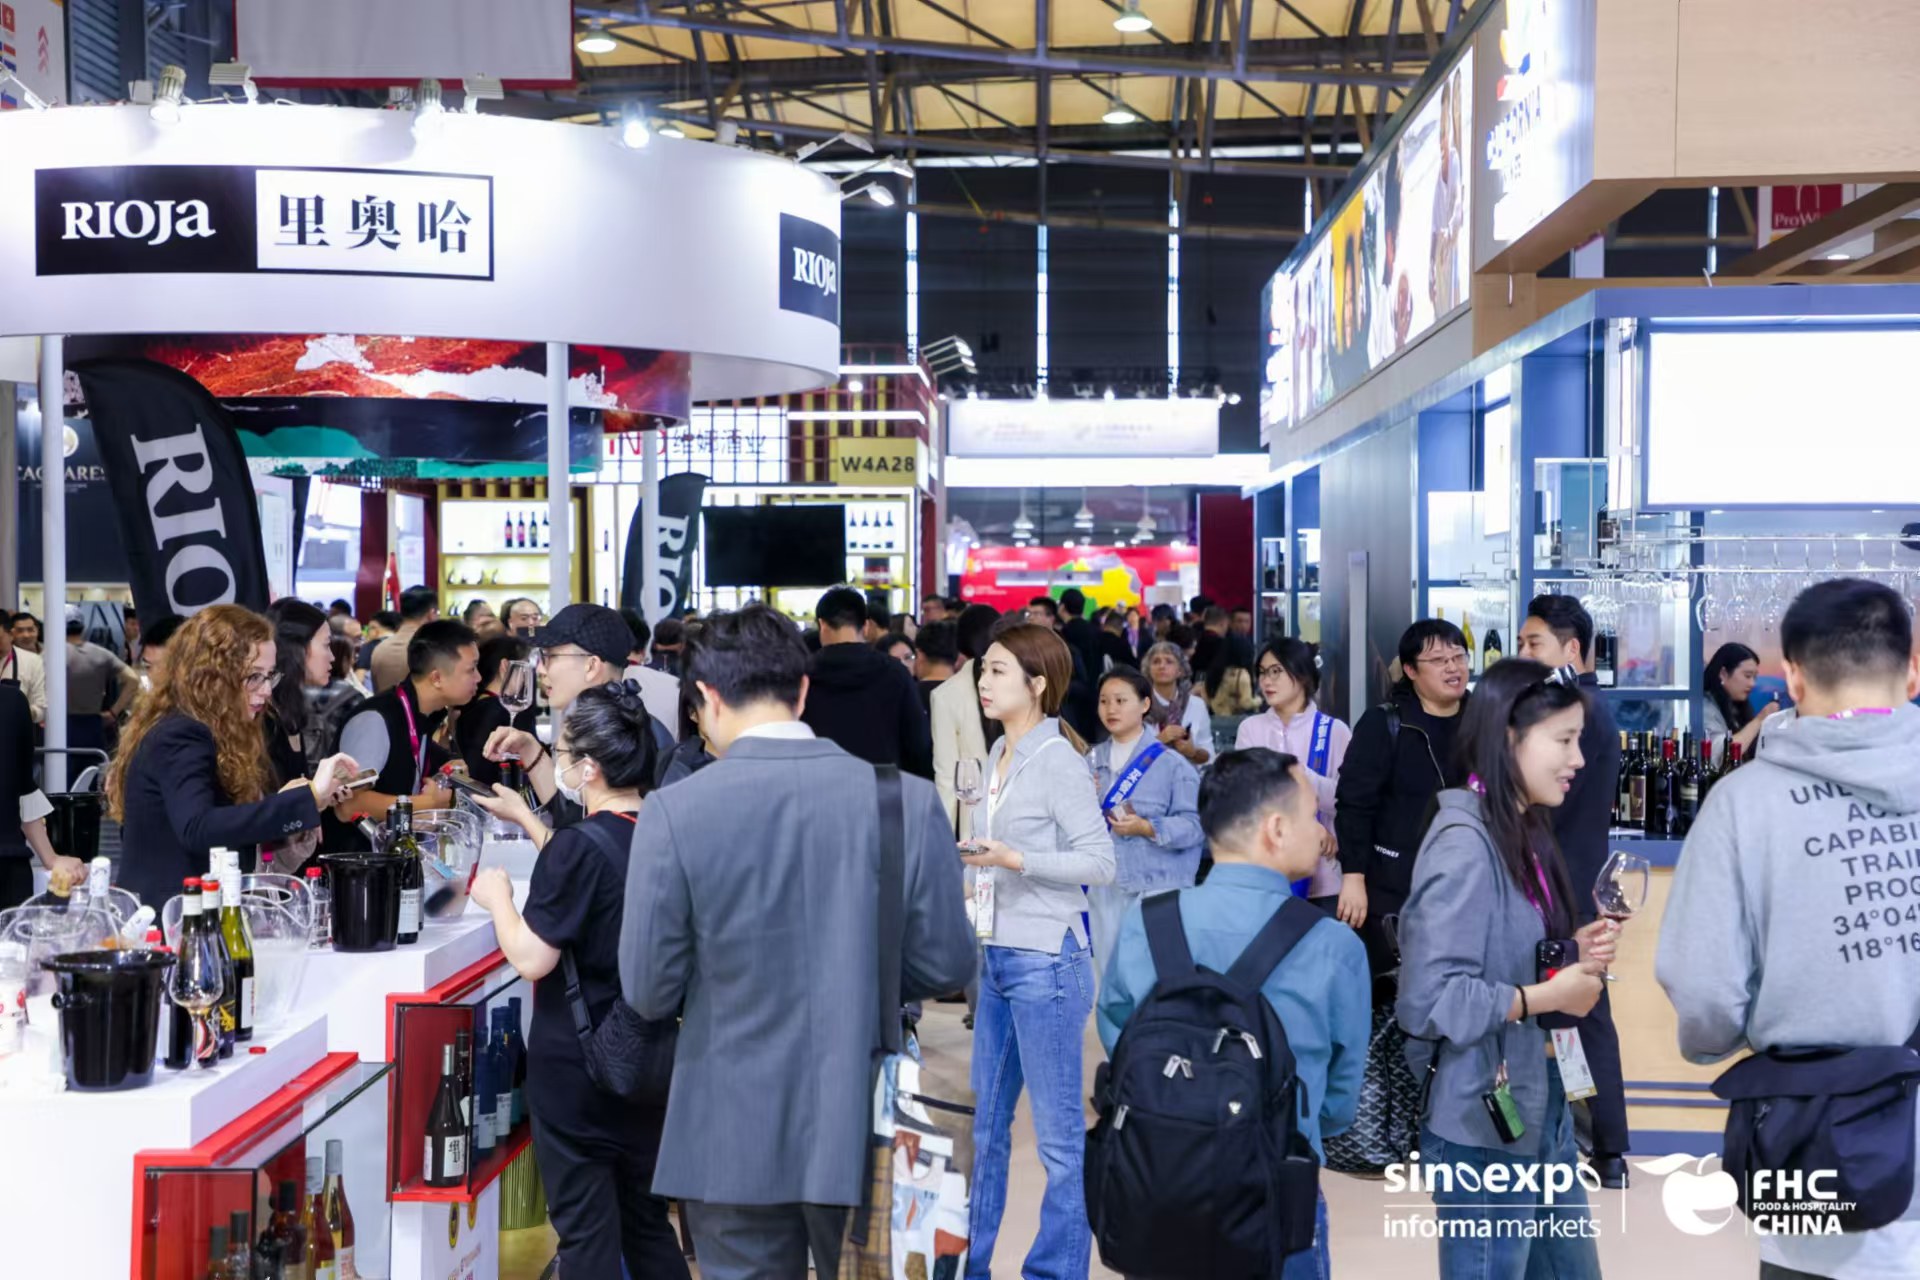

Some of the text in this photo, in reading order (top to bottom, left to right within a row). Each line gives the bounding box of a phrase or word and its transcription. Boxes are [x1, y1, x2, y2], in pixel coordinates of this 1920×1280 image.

[275, 194, 472, 254] 里奥哈
[841, 456, 915, 472] W4A28
[130, 423, 236, 618] RIO
[1790, 781, 1855, 805] UNL
[1804, 821, 1920, 857] CAPABI
